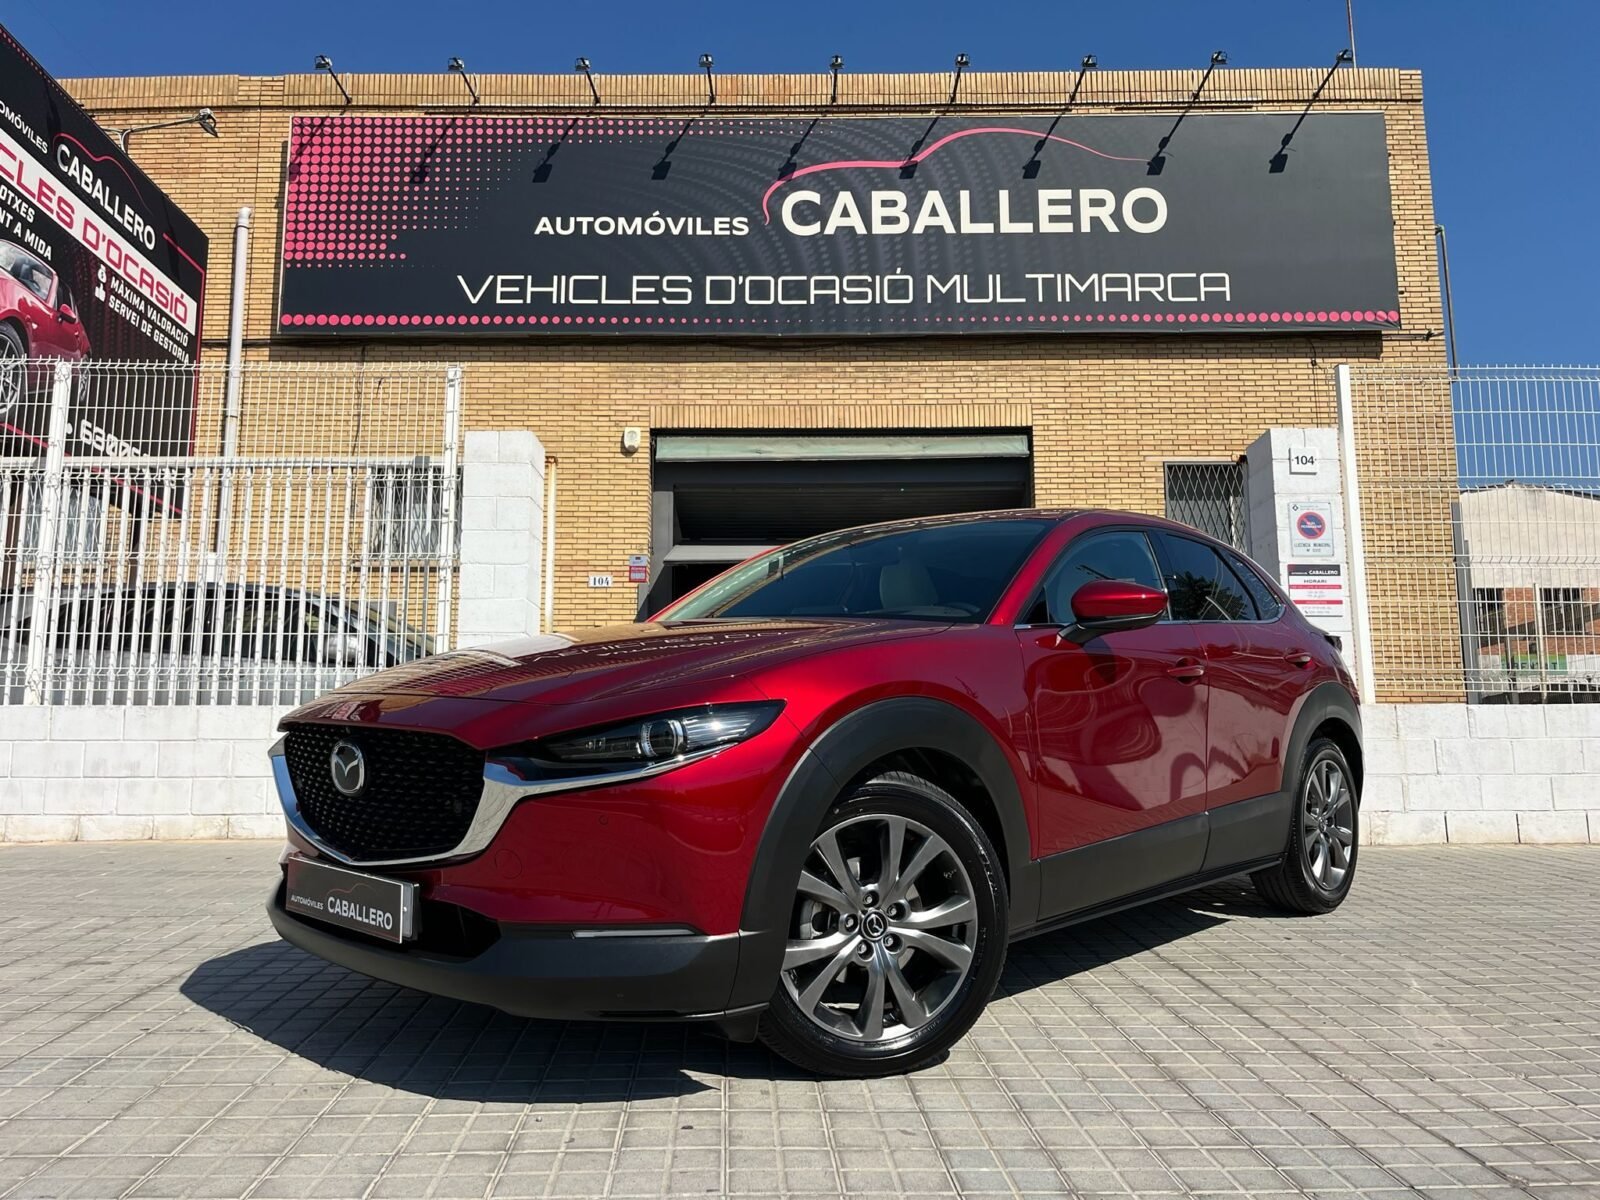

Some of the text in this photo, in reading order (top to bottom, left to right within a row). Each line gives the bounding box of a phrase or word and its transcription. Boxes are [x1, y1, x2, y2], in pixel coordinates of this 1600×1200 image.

[57, 143, 155, 250] CABALLERO
[534, 187, 1168, 236] AUTOMÓVILES CABALLERO
[13, 222, 22, 238] A
[24, 229, 52, 260] MIDA
[82, 217, 188, 325] D'OCASIÓ
[456, 267, 1231, 305] VEHICLES D'OCASIÓ MULTIMARCA
[108, 295, 190, 364] SERVEI DE GESTORIA
[110, 276, 189, 347] MÀXIMA VALORACIÓ
[1294, 455, 1315, 465] 104
[593, 577, 609, 585] 104
[291, 894, 393, 930] AUTOMÓVILES CABALLERO
